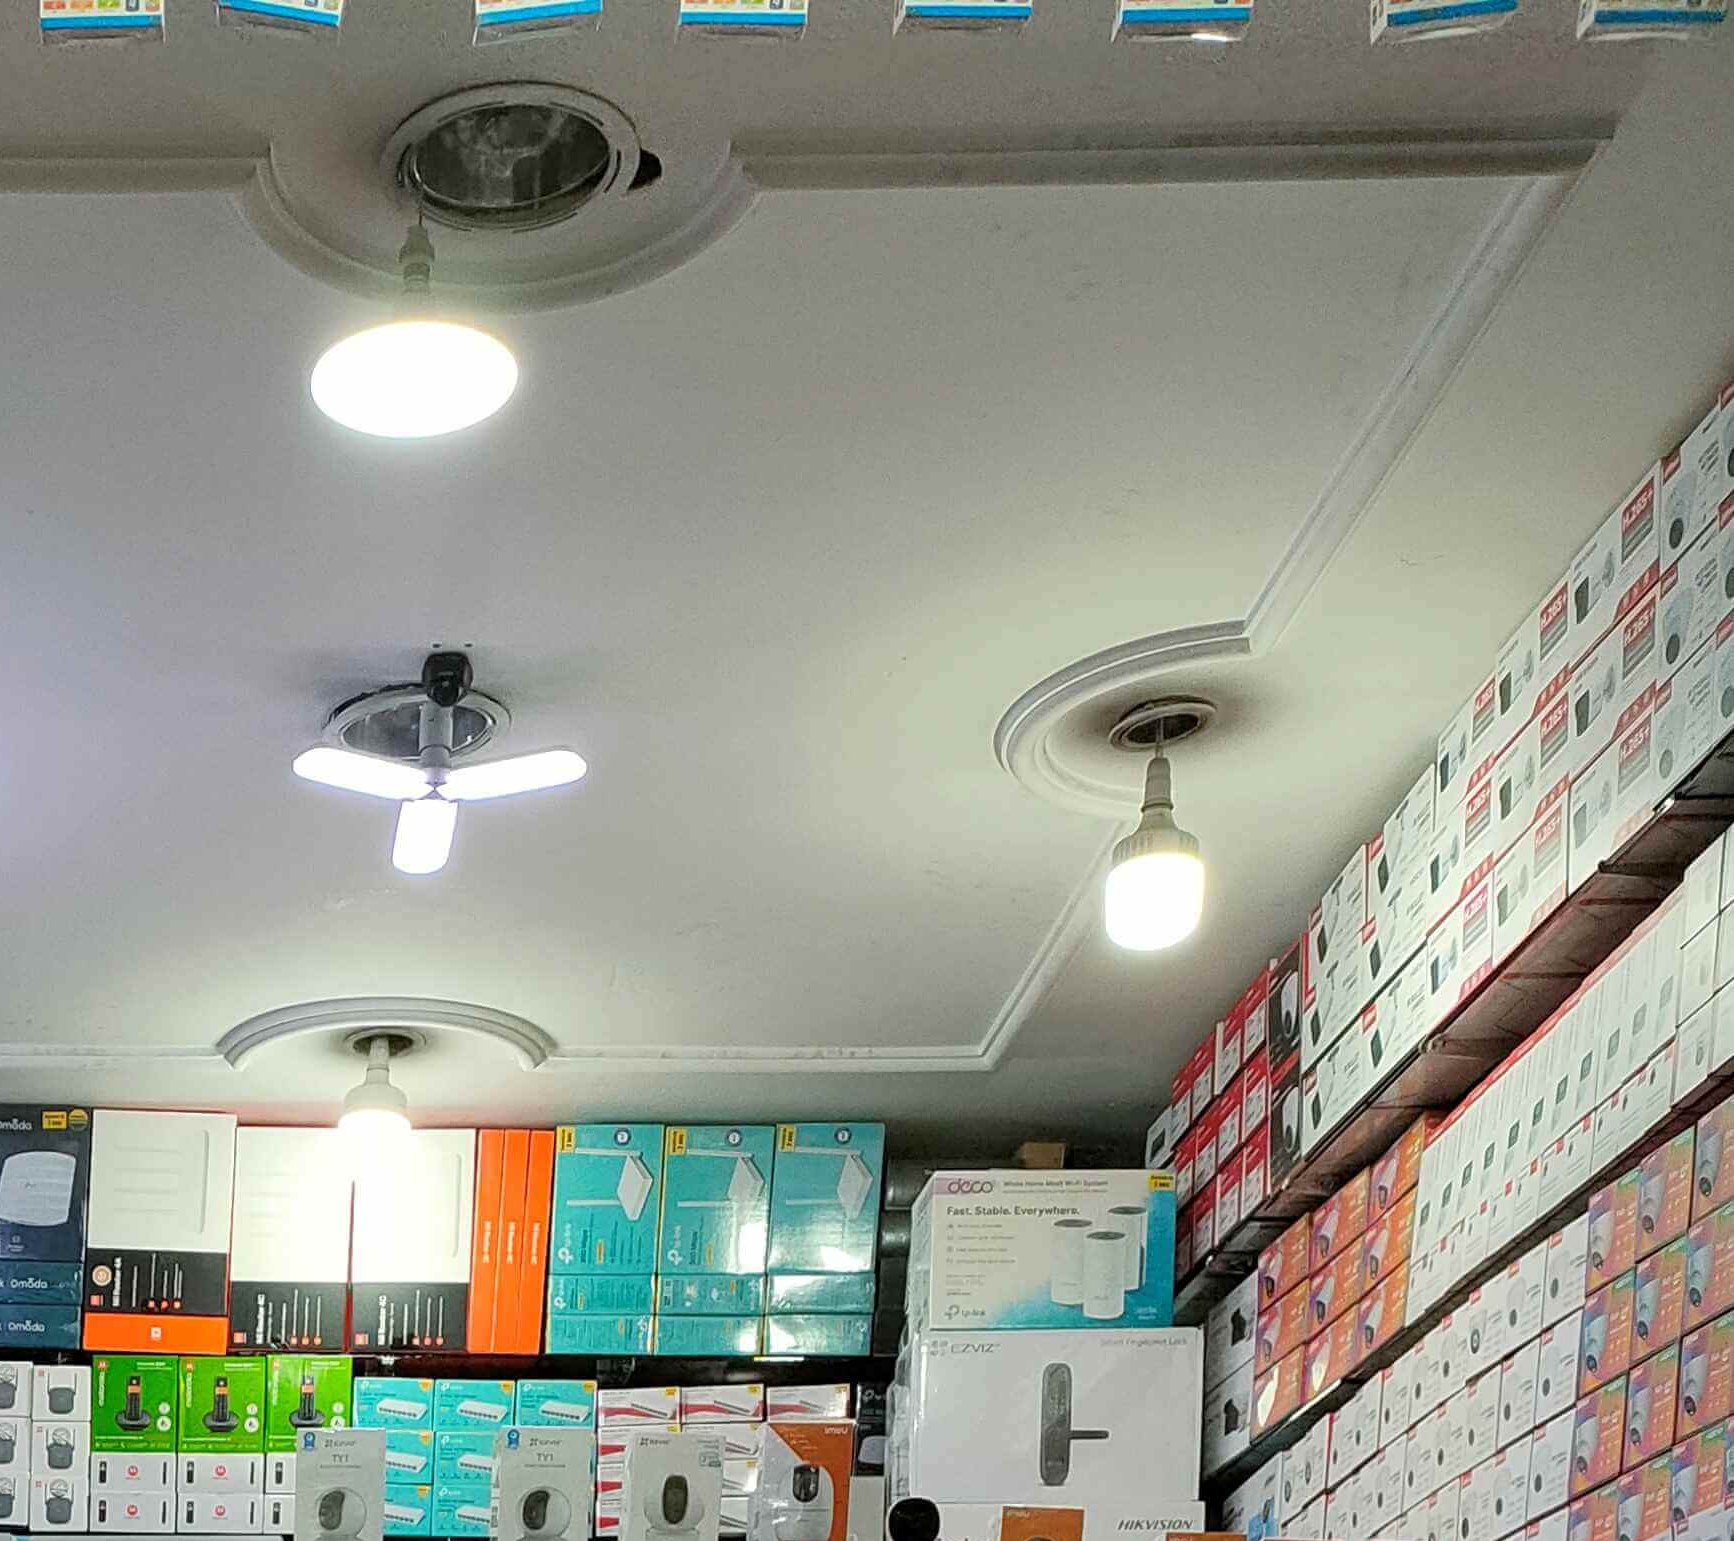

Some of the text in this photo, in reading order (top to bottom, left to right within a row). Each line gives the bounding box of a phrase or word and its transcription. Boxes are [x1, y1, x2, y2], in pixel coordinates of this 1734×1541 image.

[947, 1178, 994, 1194] deco
[946, 1206, 1080, 1217] Fast. Stable. Everywhere.
[10, 1278, 48, 1290] Omada
[8, 1321, 45, 1333] Omada
[1117, 1519, 1194, 1531] HIKVISION
